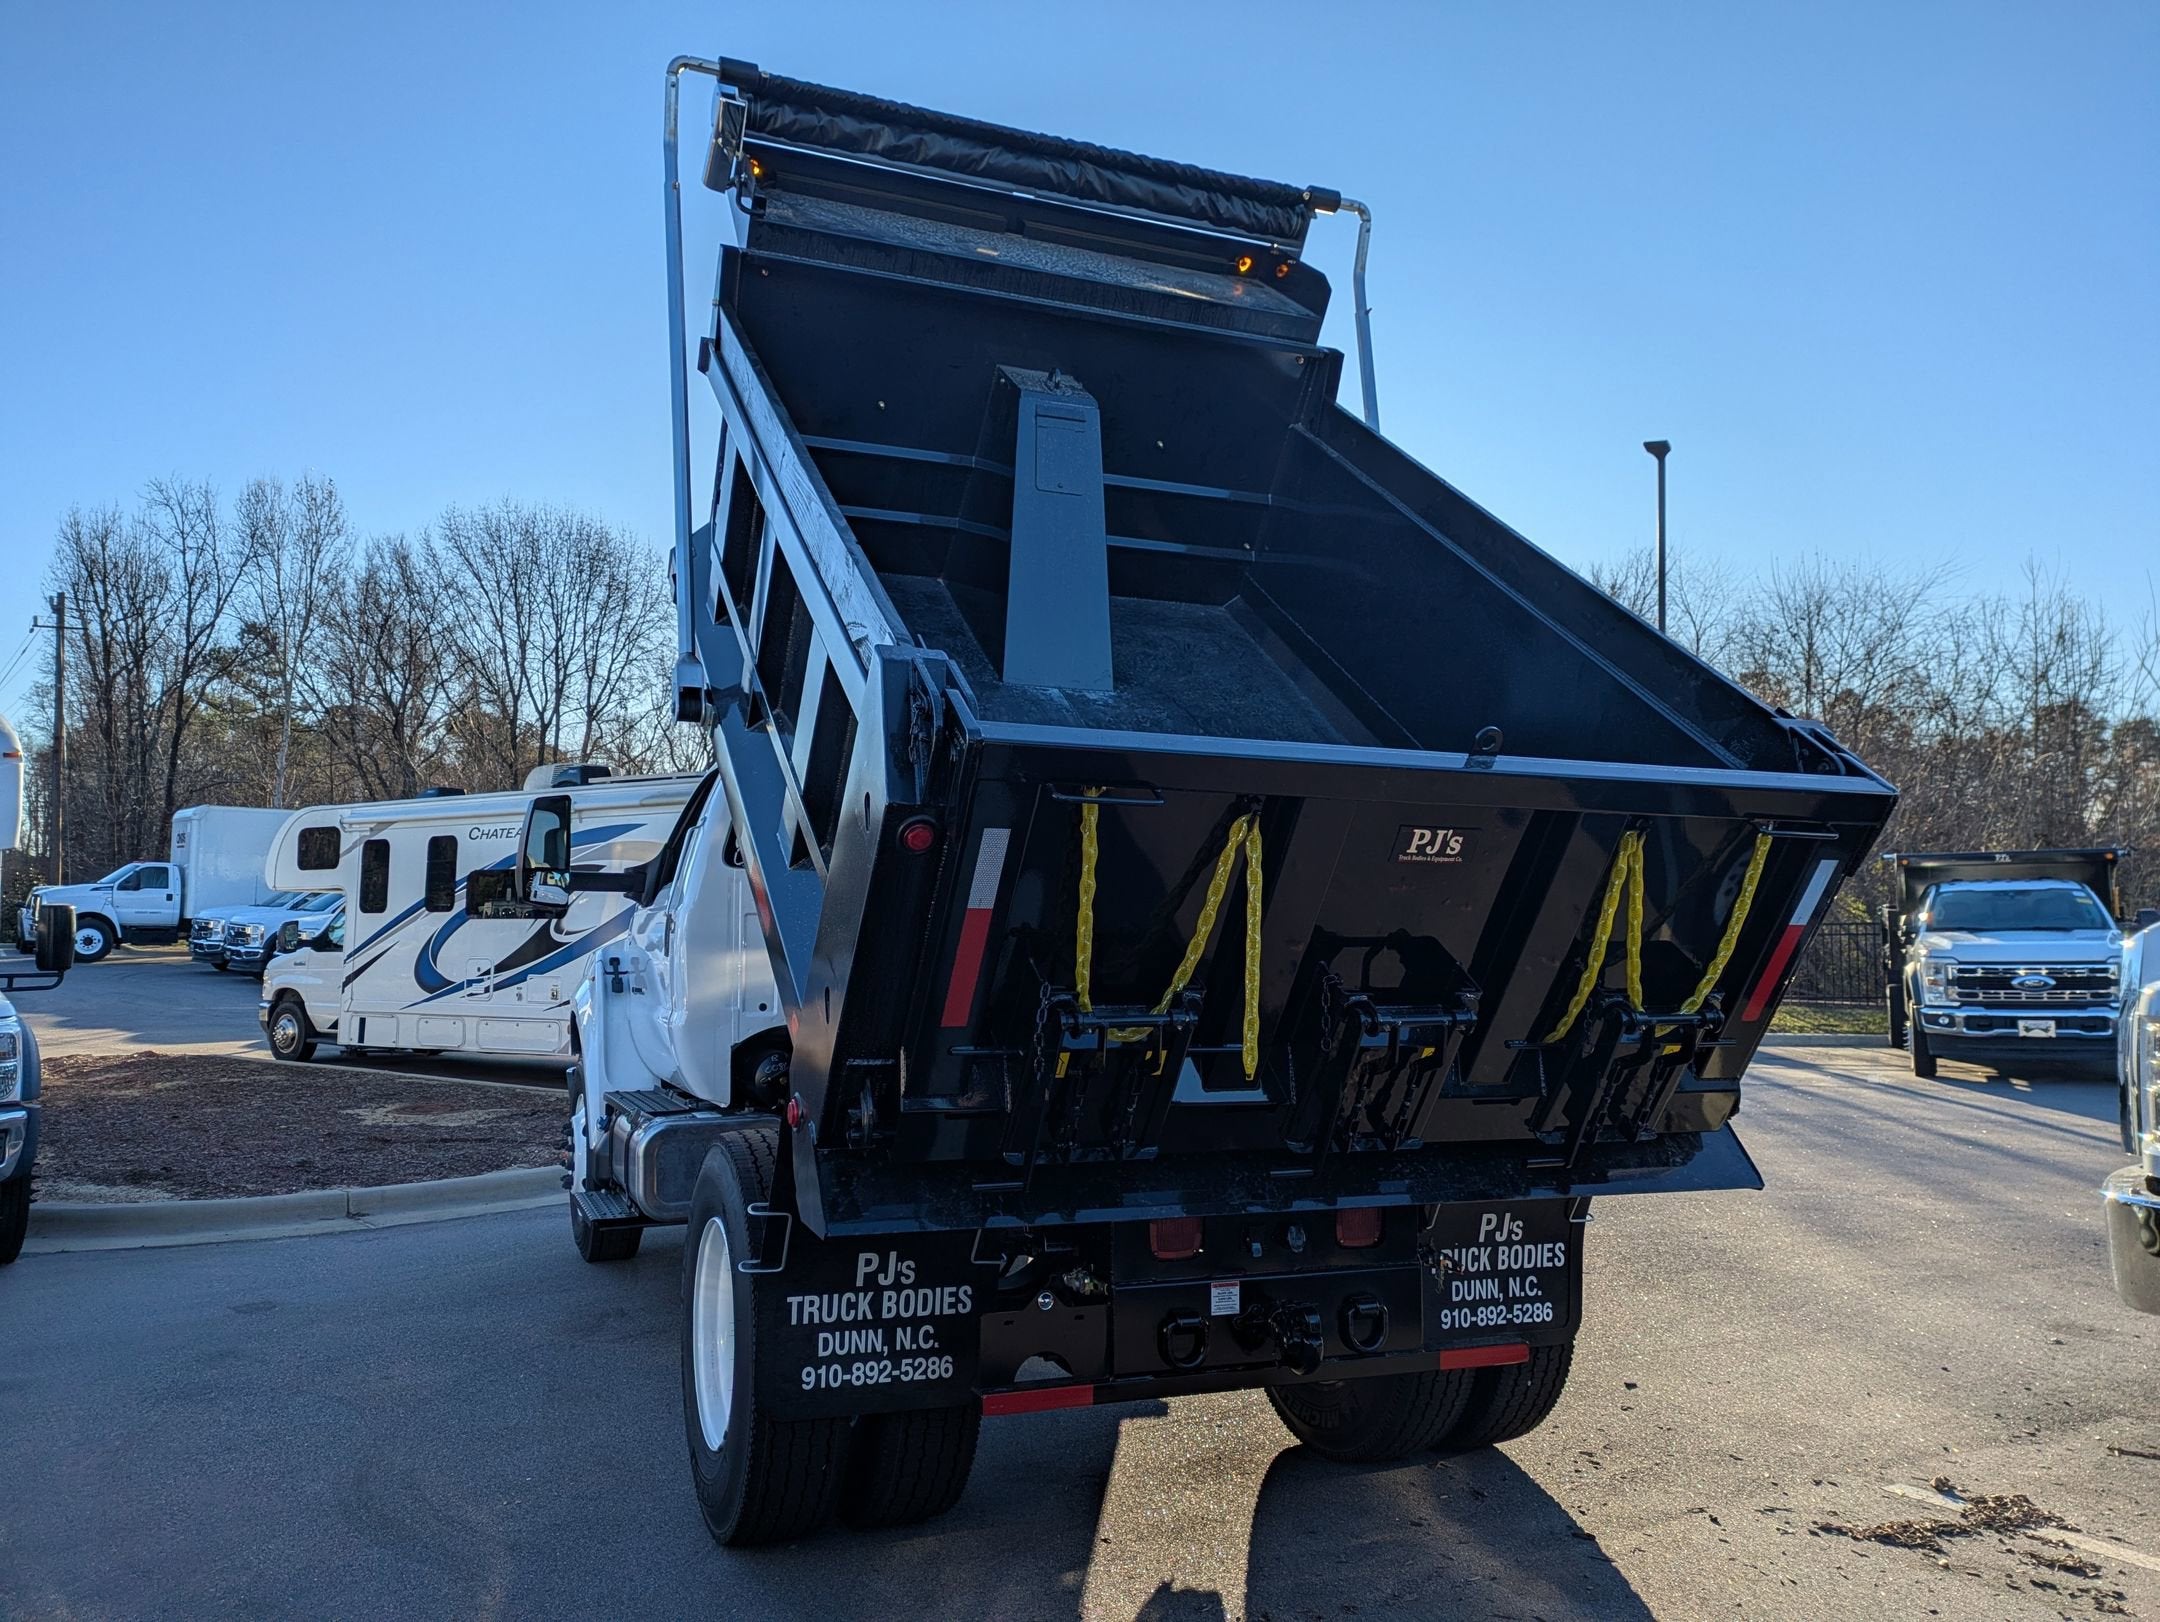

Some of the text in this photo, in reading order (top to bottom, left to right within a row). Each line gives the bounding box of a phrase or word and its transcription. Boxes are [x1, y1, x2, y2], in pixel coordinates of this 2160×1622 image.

[468, 826, 522, 840] CHATEA
[1406, 829, 1464, 855] PJ's
[1479, 1212, 1524, 1242] PJ's
[855, 1251, 916, 1287] PJ's
[1431, 1242, 1565, 1274] RUCK BODIES
[1451, 1275, 1542, 1302] DUNN, N.C.
[786, 1285, 973, 1326] TRUCK BODIES
[1440, 1302, 1553, 1329] 910-892-5286
[818, 1324, 940, 1357] DUNN, N.C.
[801, 1355, 954, 1391] 910-892-5286
